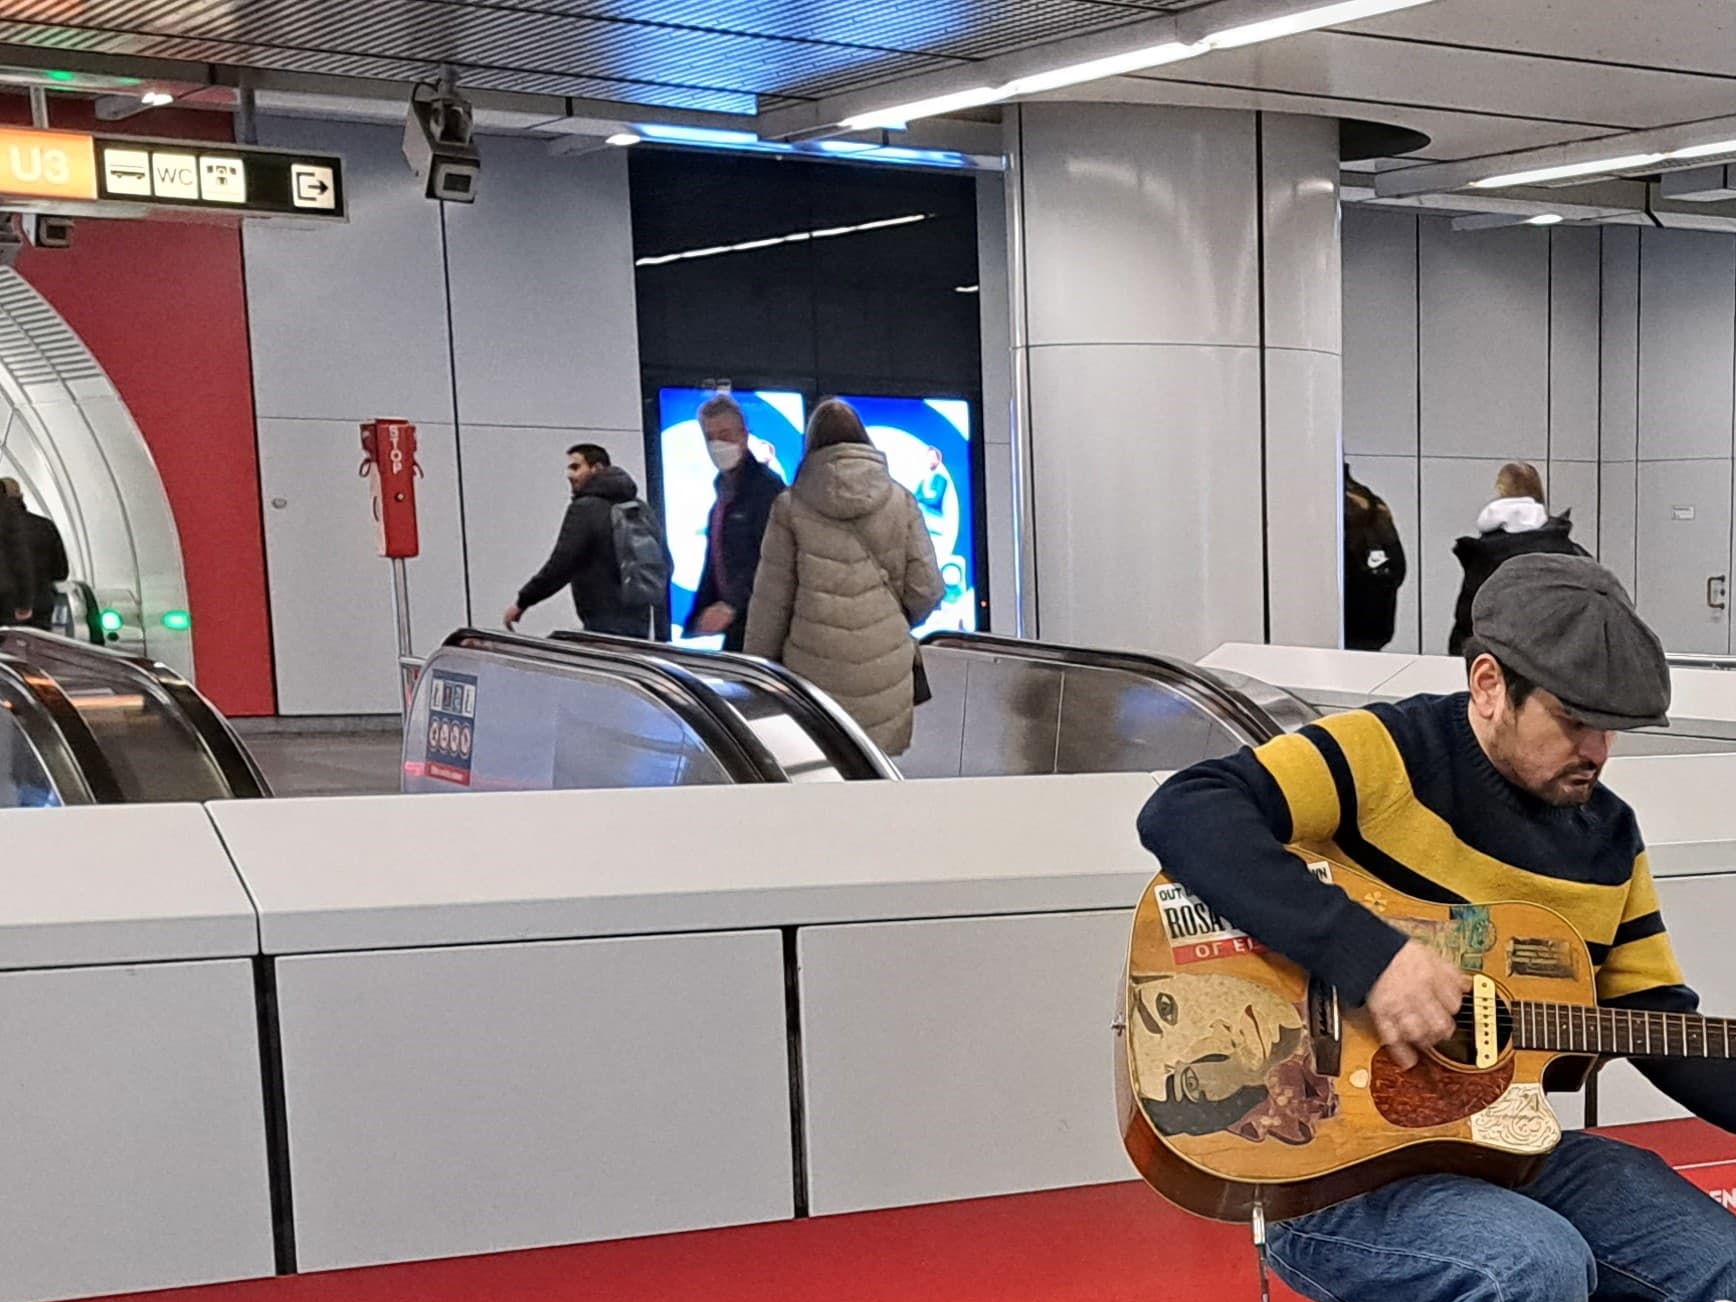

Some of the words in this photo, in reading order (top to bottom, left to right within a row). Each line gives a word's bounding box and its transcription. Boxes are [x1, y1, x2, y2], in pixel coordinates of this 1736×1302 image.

[9, 145, 70, 185] U3
[157, 167, 194, 187] WC
[388, 425, 403, 475] STOP
[1194, 942, 1224, 959] OF
